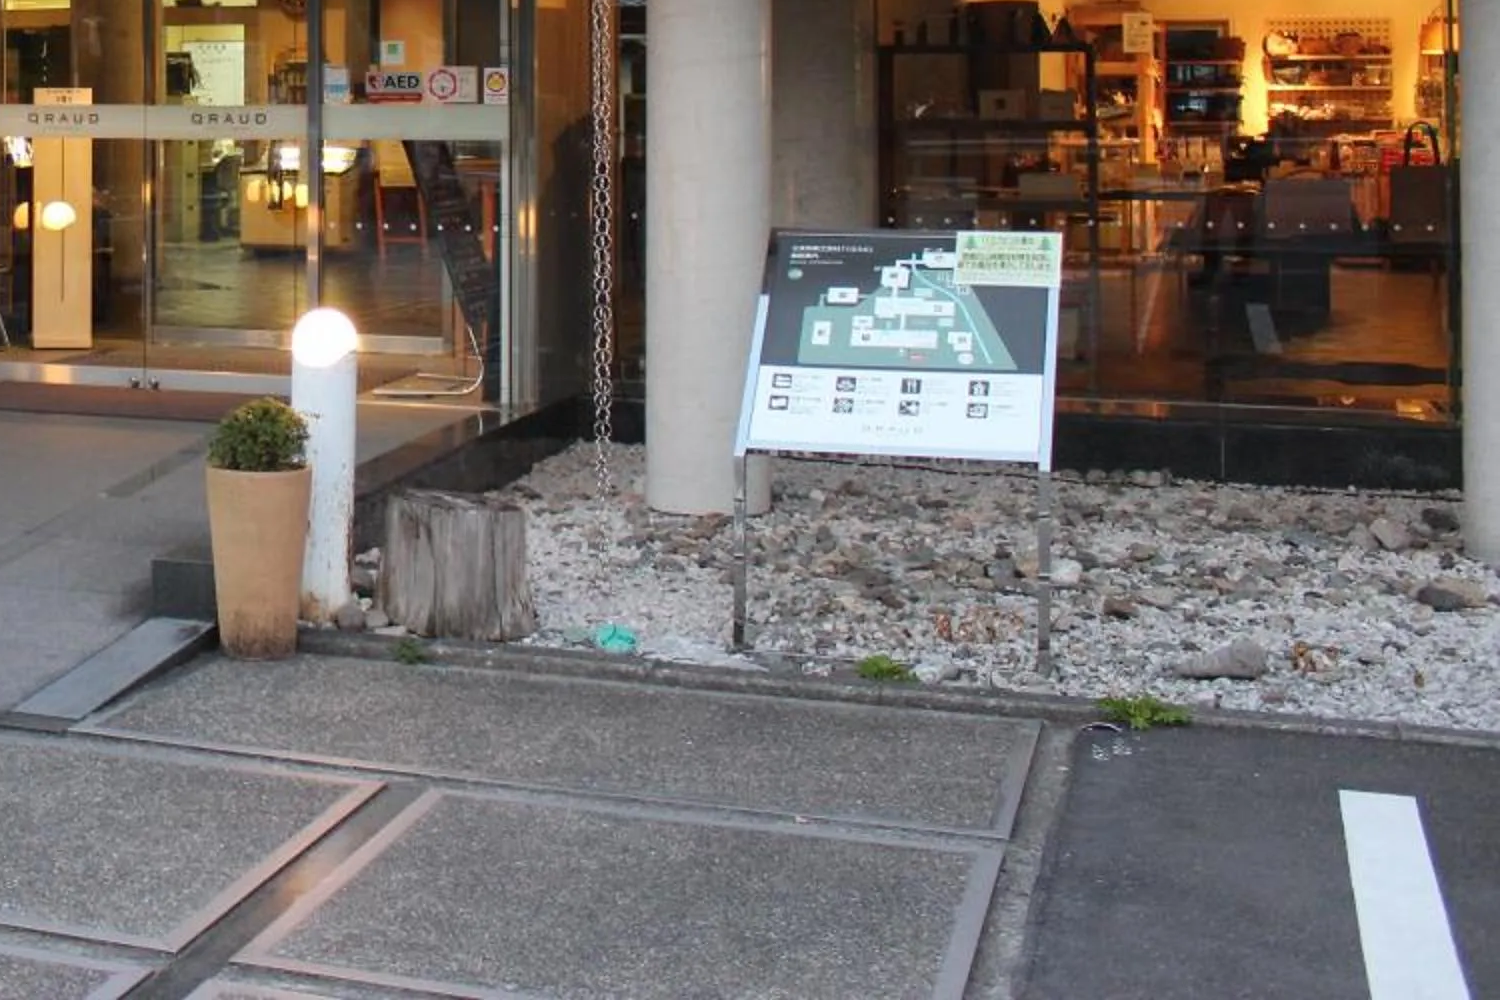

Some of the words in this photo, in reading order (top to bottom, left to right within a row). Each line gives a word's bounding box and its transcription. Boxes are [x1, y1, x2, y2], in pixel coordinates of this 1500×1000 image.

[383, 75, 420, 89] AED
[27, 112, 99, 125] QRAUD
[191, 112, 267, 125] QRAUD
